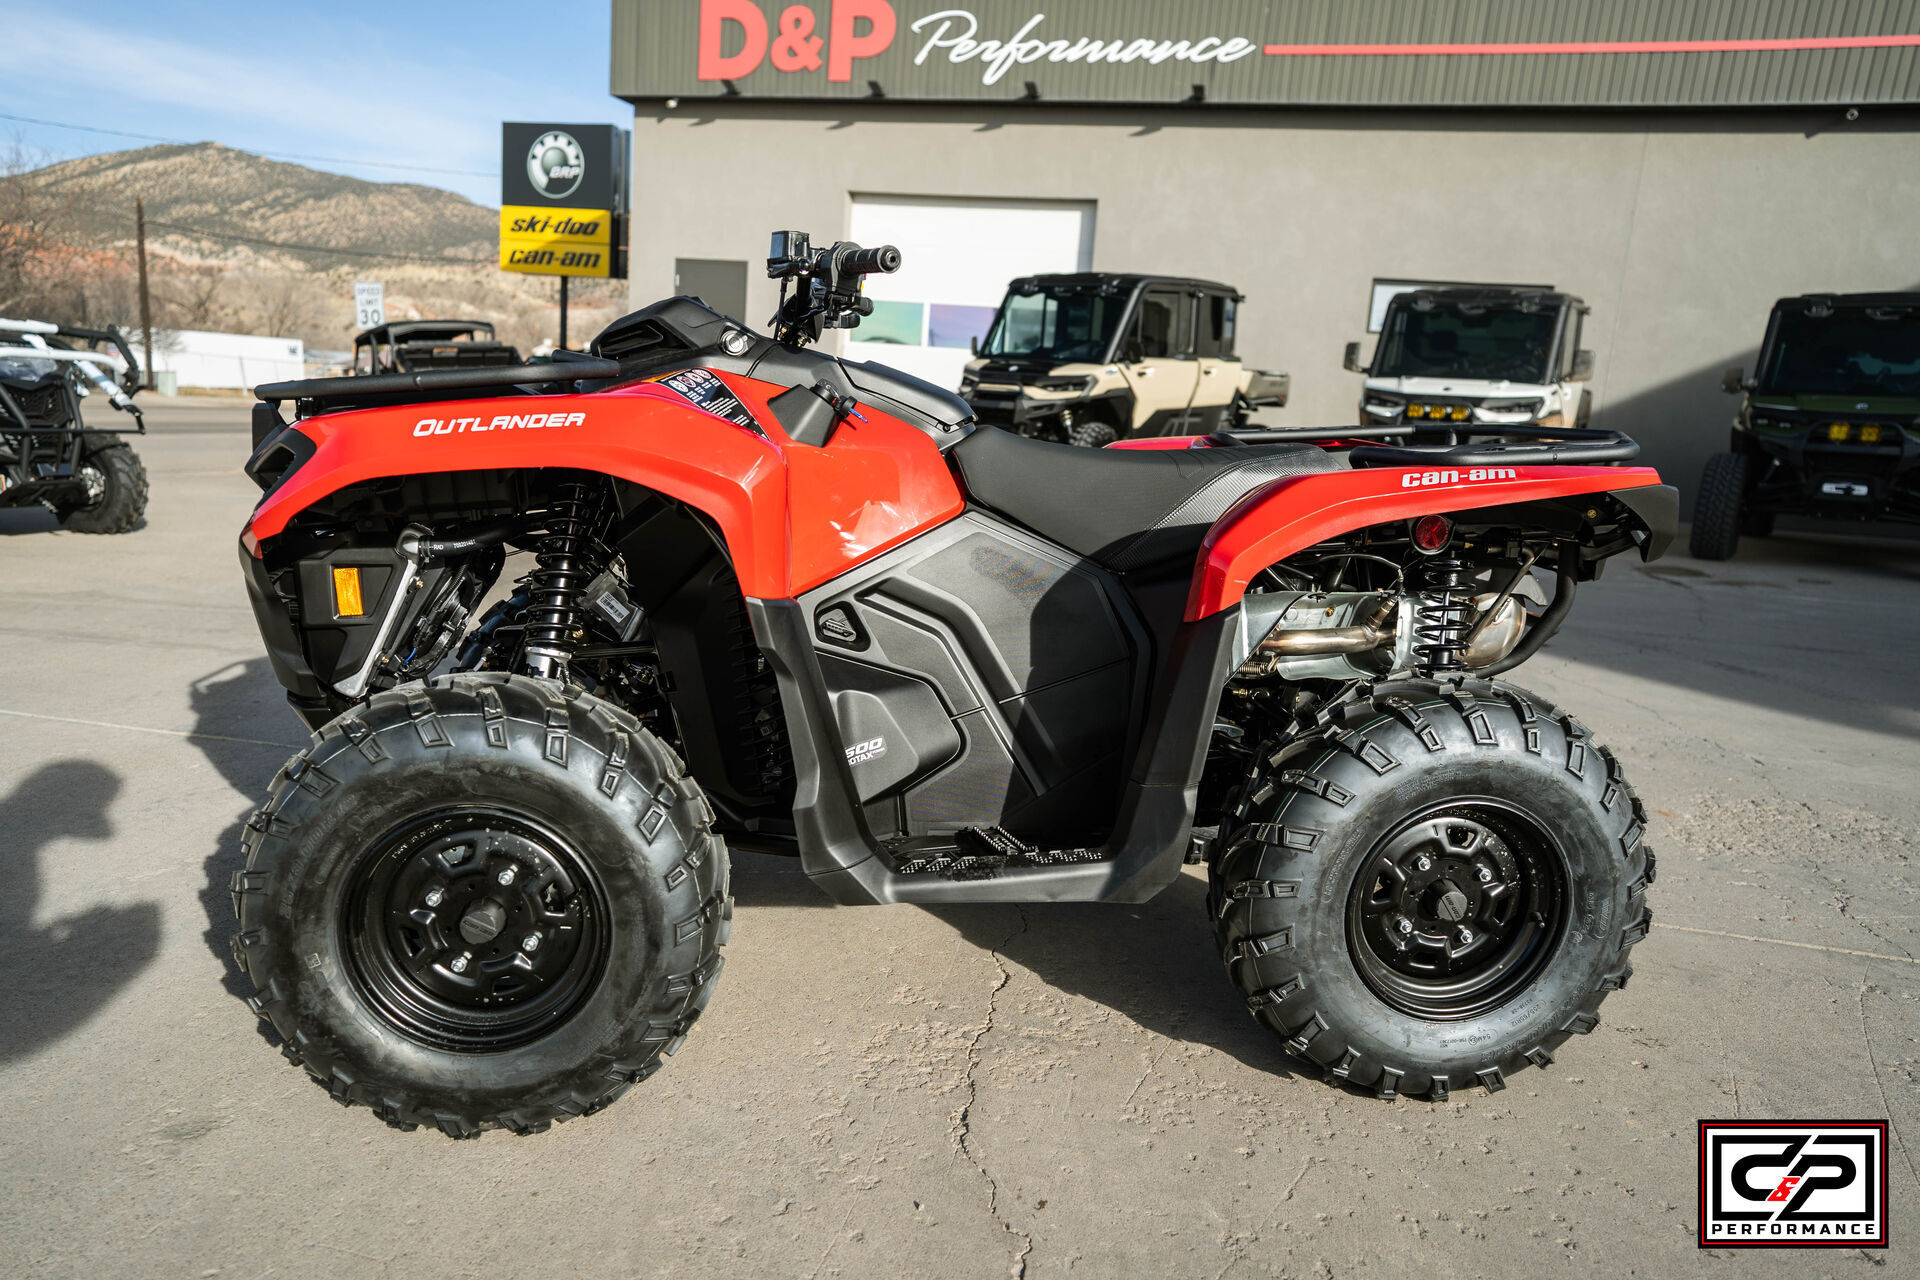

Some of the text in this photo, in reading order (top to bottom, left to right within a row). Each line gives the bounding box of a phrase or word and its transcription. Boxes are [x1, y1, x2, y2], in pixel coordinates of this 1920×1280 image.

[698, 0, 1257, 85] D&P Performance
[550, 165, 580, 179] BRP
[511, 215, 600, 236] ski-doo
[509, 249, 602, 269] can-am
[360, 309, 381, 325] 30
[412, 412, 586, 437] OUTLANDER
[1401, 468, 1516, 488] can-am
[845, 737, 883, 759] 500
[848, 751, 874, 766] OTAX
